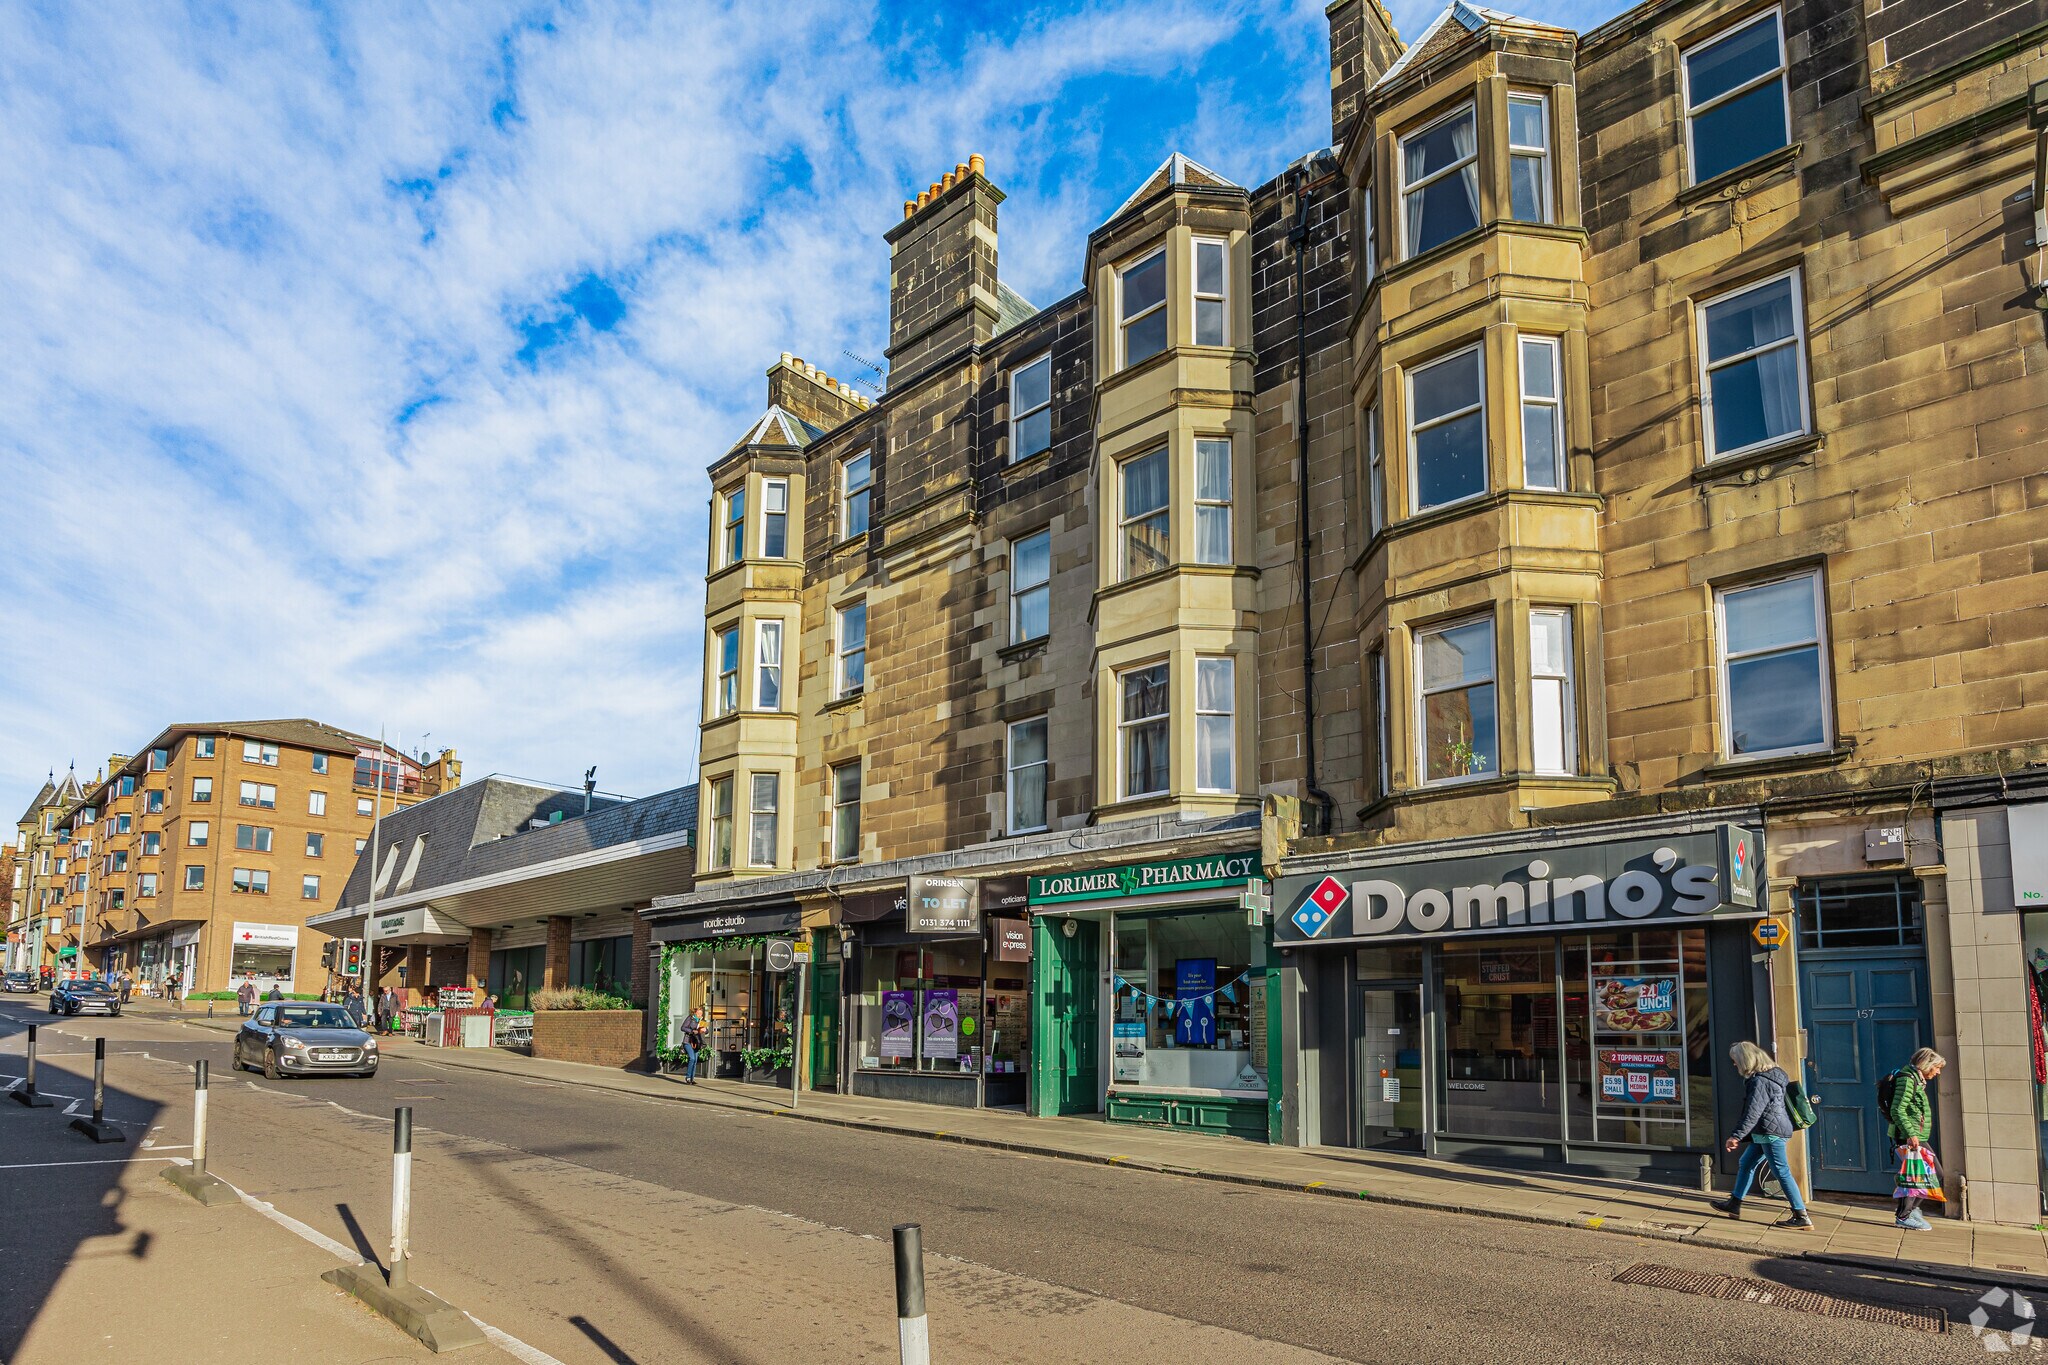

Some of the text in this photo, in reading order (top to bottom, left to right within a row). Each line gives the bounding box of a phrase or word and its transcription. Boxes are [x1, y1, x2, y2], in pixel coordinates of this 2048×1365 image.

[1039, 857, 1253, 896] LORIMER PHARMACY
[925, 880, 964, 888] ORINSEN
[1352, 847, 1722, 935] Domino's
[1733, 883, 1752, 898] Domino's
[2023, 891, 2044, 899] No.
[922, 898, 967, 909] TO LET
[1001, 895, 1027, 905] opticians
[703, 915, 745, 929] nordic studio
[920, 919, 971, 927] 0131 374 1111
[1006, 931, 1023, 940] vision
[1002, 941, 1027, 950] express
[1481, 964, 1510, 974] STUFFED
[1488, 972, 1510, 982] CRUST
[1640, 984, 1657, 998] £4
[1638, 995, 1671, 1010] LUNCH
[1856, 1009, 1875, 1019] 157
[1617, 1054, 1642, 1062] TOPPING
[1605, 1077, 1622, 1085] £5.99
[1630, 1075, 1647, 1083] £7.99
[1655, 1079, 1674, 1087] £9.99
[1448, 1082, 1485, 1090] WELCOME
[1605, 1085, 1622, 1093] SMALL
